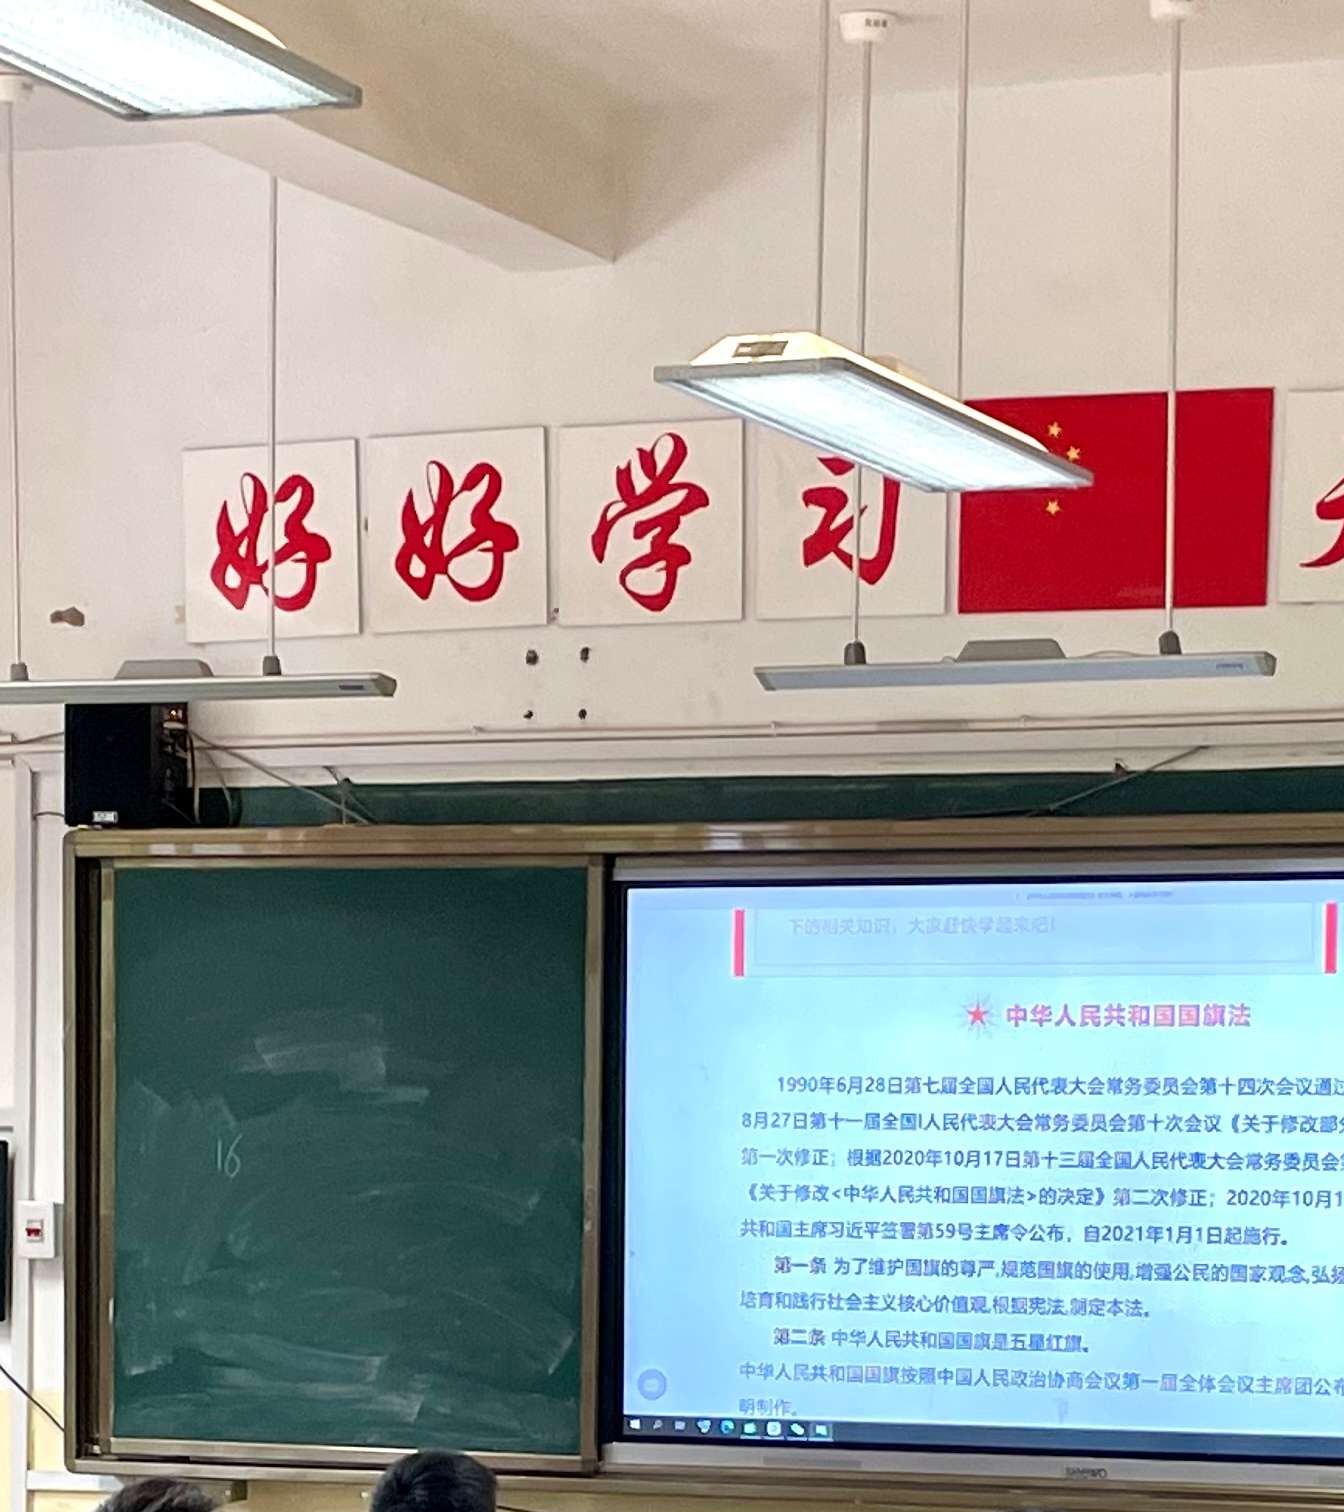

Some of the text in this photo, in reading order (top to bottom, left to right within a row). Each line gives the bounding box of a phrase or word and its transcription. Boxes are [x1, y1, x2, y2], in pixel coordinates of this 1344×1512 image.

[1006, 1003, 1251, 1028] 中华人民共和国国旗法
